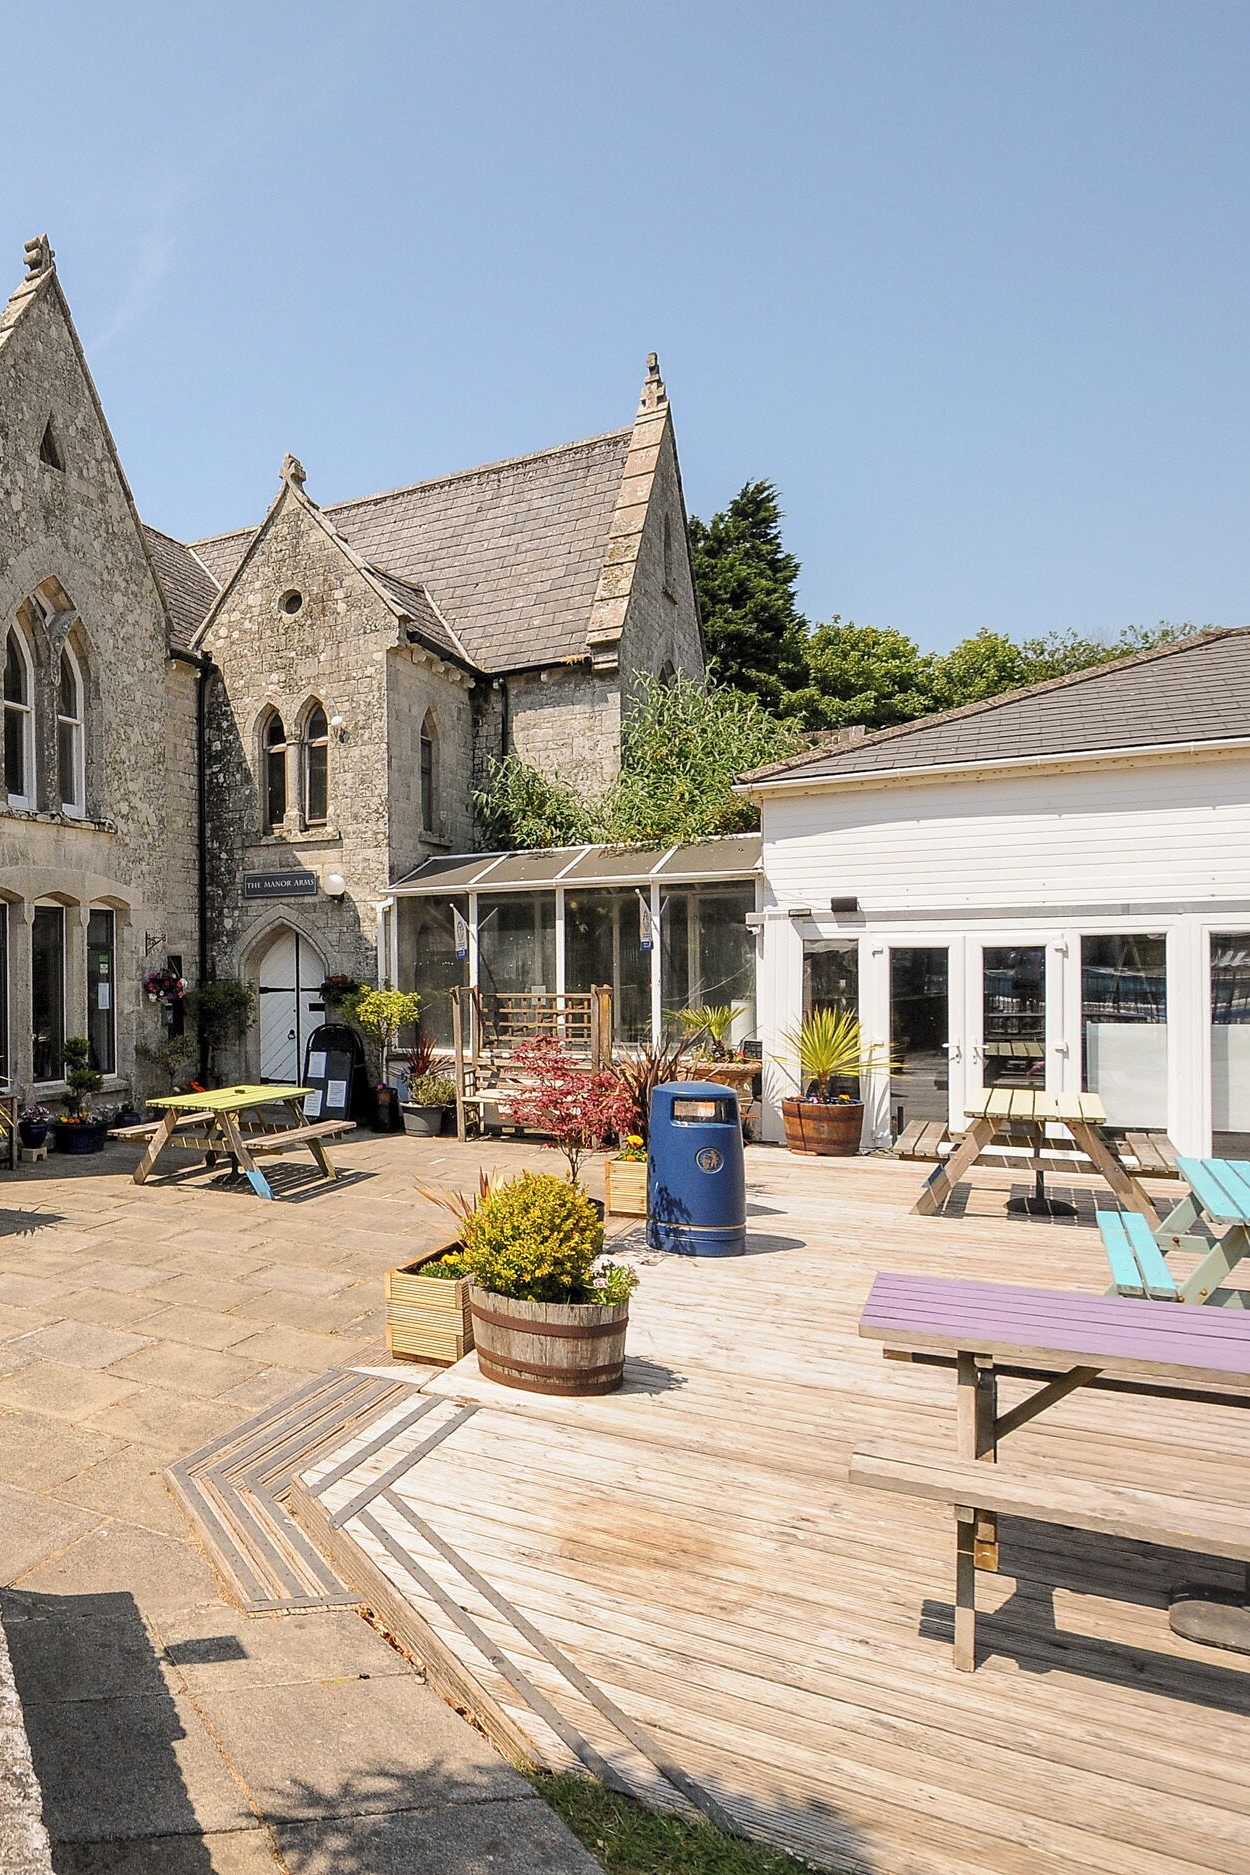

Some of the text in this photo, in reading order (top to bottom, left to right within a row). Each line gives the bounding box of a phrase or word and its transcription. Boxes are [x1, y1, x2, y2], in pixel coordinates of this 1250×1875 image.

[247, 879, 314, 889] THE MANOR ARMS
